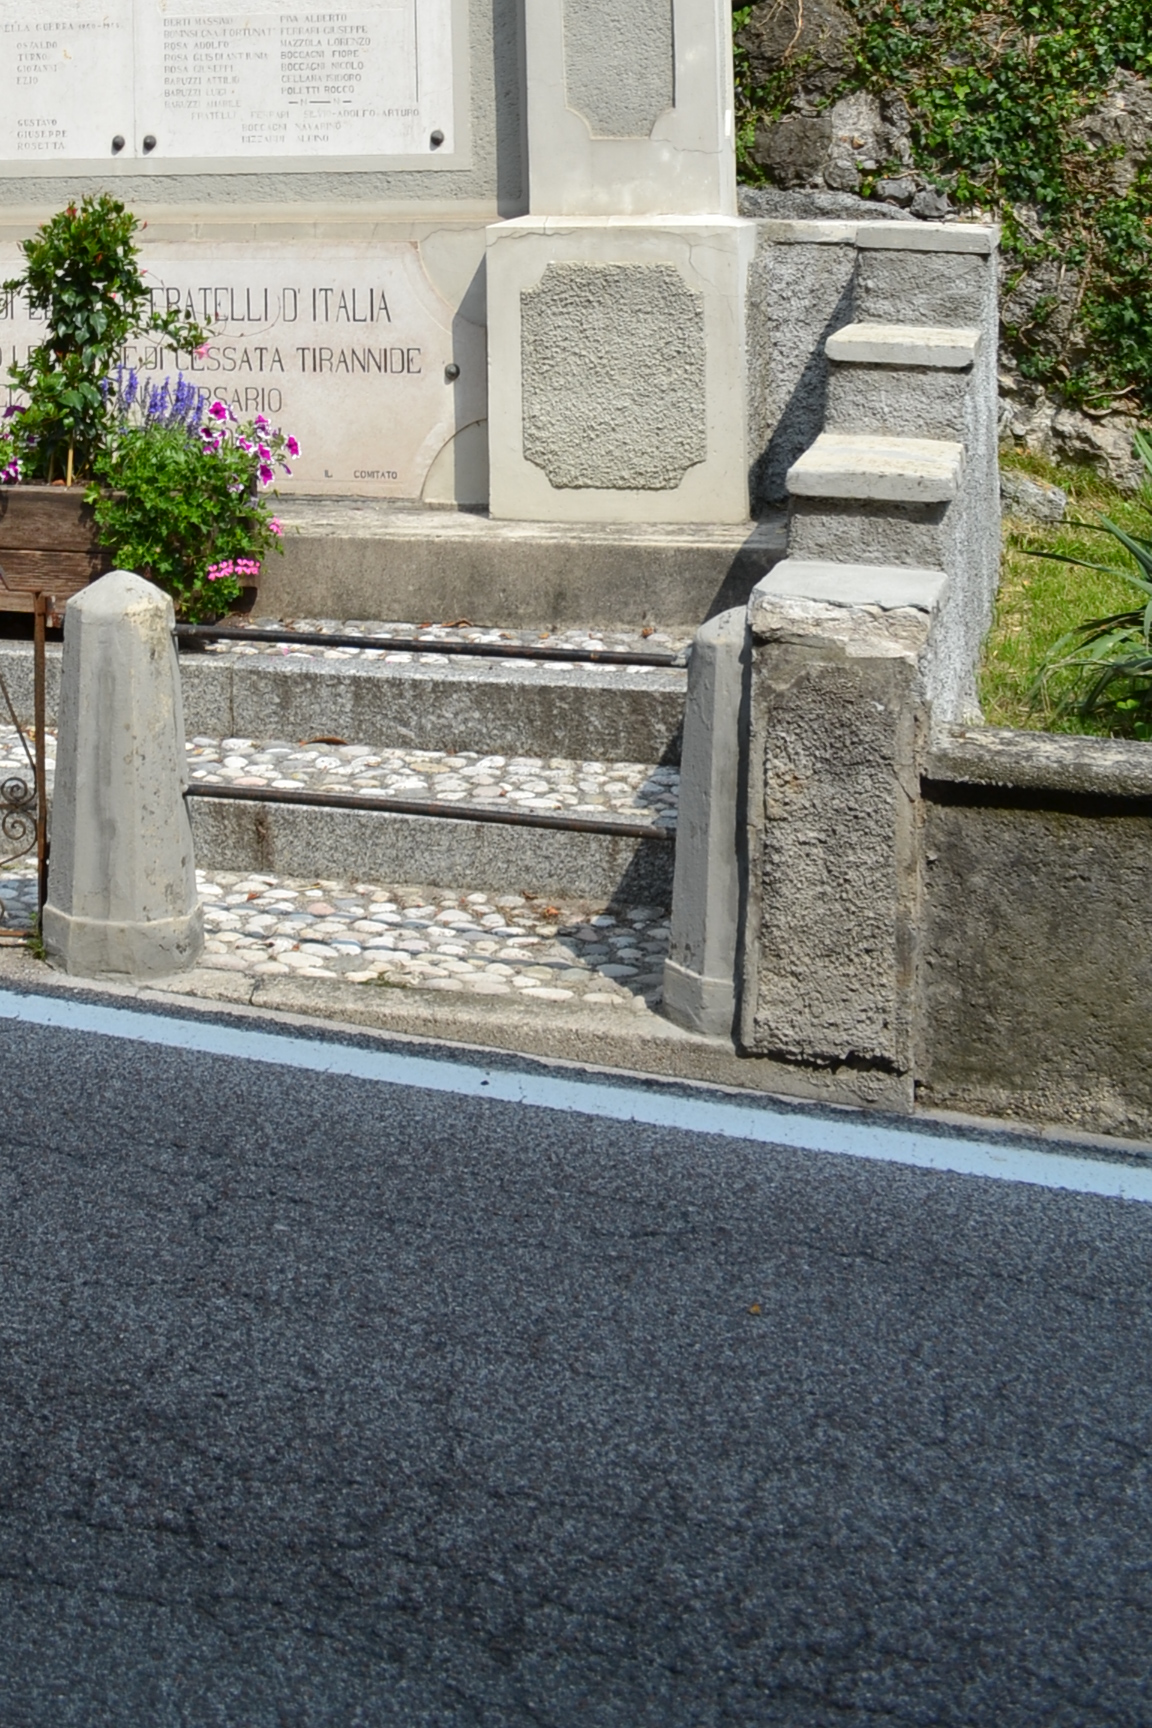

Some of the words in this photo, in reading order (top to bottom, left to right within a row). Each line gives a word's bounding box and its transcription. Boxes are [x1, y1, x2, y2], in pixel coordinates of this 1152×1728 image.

[304, 14, 346, 22] ALBERTO
[36, 23, 74, 31] GUERRA
[324, 25, 368, 33] GIUSEPPE
[164, 42, 188, 50] ROSA
[194, 41, 229, 49] ADOLFO
[280, 39, 322, 47] MAZZOLA
[328, 38, 370, 46] LORENZO
[164, 54, 188, 62] ROSA
[281, 51, 324, 59] BOCCAGNI
[332, 50, 359, 58] FIORE
[281, 63, 325, 71] BOCCAGNI
[331, 62, 364, 70] NICOLO
[16, 76, 38, 85] EZIO
[164, 77, 201, 85] BARUZZI
[164, 89, 201, 97] BARUZZI
[324, 85, 354, 93] ROCCO
[17, 119, 58, 127] GUSTAVO
[16, 130, 68, 139] GIUSEPPE
[17, 141, 65, 150] ROSETTA
[150, 286, 268, 322] FRATELLI
[312, 287, 392, 323] ITALIA
[145, 346, 164, 370] DI
[175, 346, 284, 372] CESSATA
[296, 347, 422, 374] TIRANNIDE
[325, 470, 333, 478] IL
[354, 471, 397, 479] COMITATO
